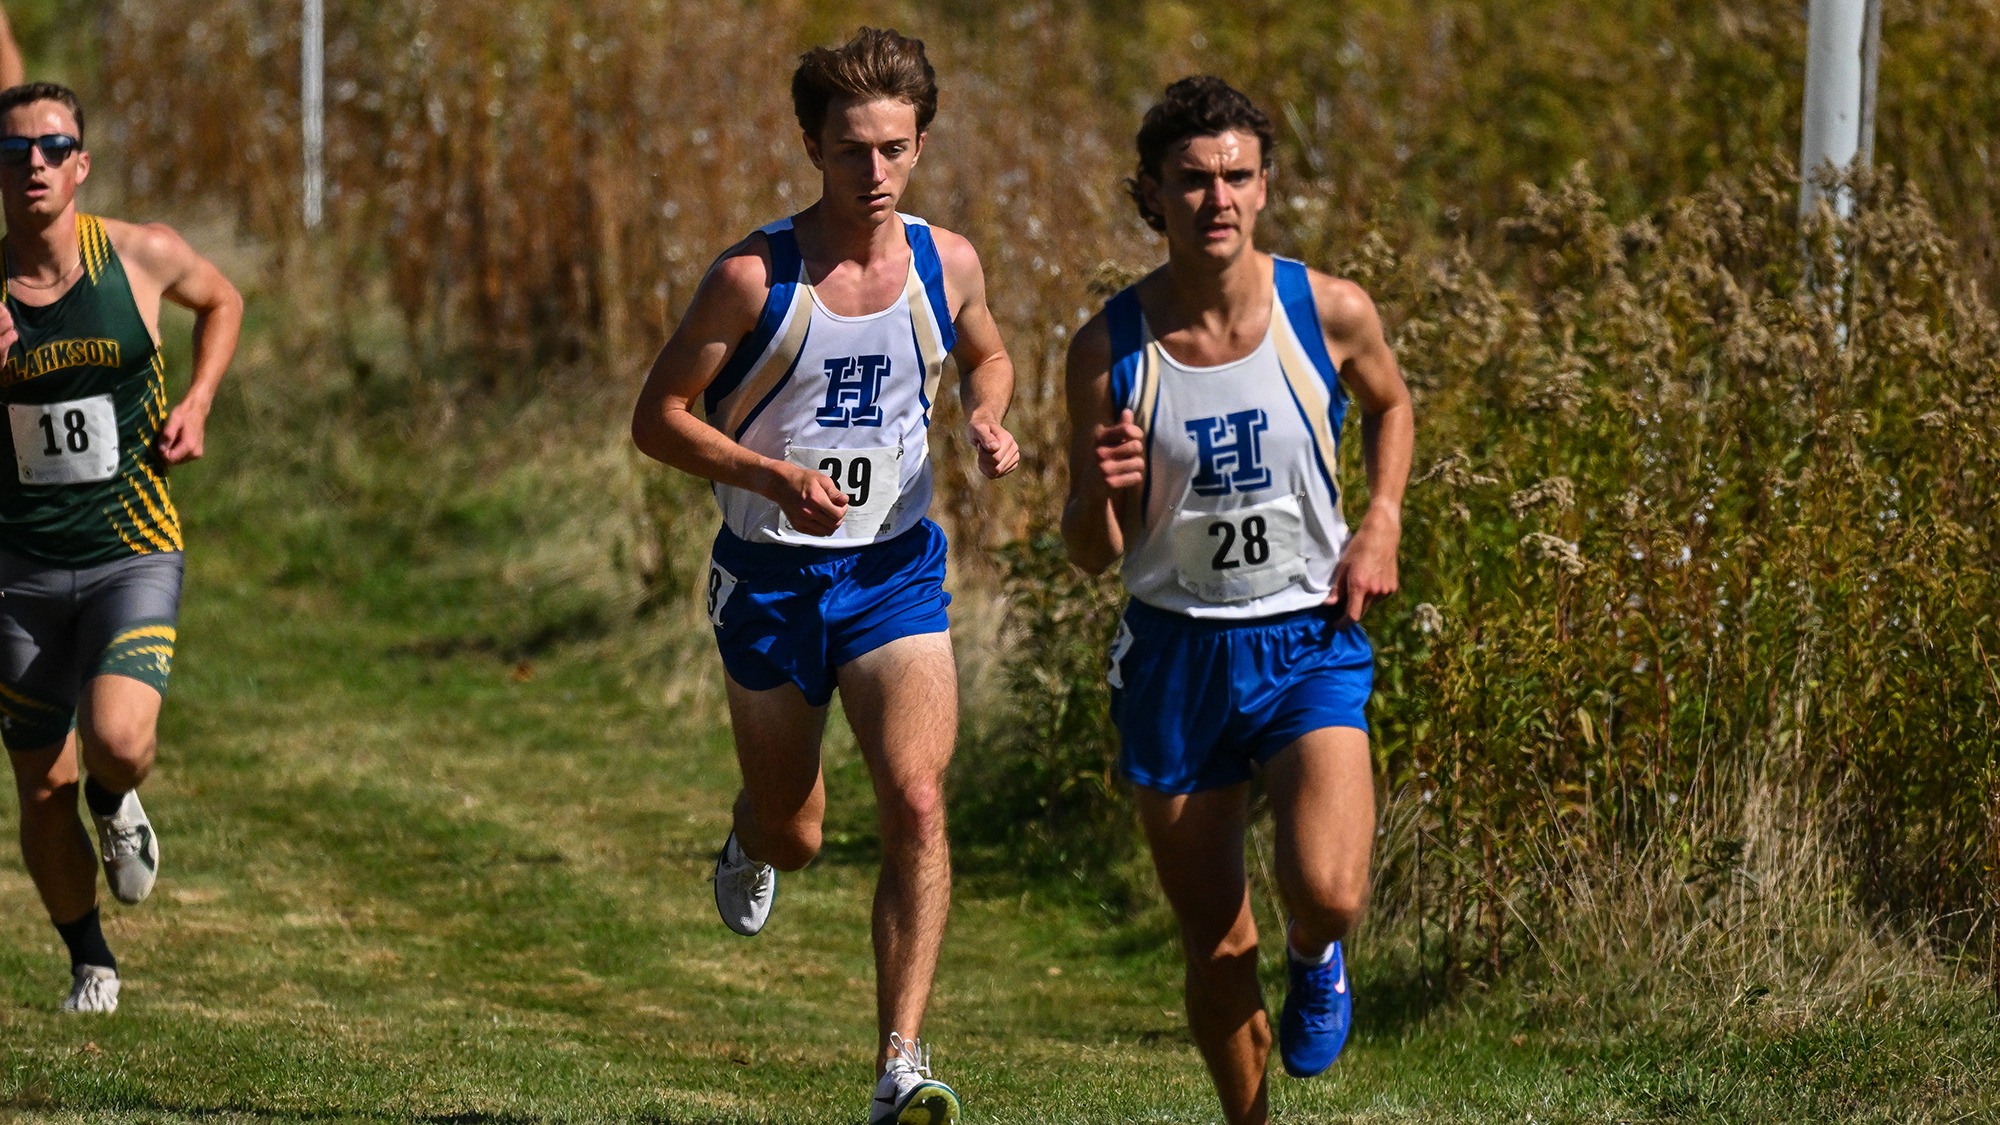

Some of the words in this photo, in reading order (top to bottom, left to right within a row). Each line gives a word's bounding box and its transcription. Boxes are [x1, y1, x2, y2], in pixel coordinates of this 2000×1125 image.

[815, 354, 892, 428] H
[38, 408, 90, 457] 18
[1184, 408, 1272, 497] H
[1208, 515, 1270, 571] 28
